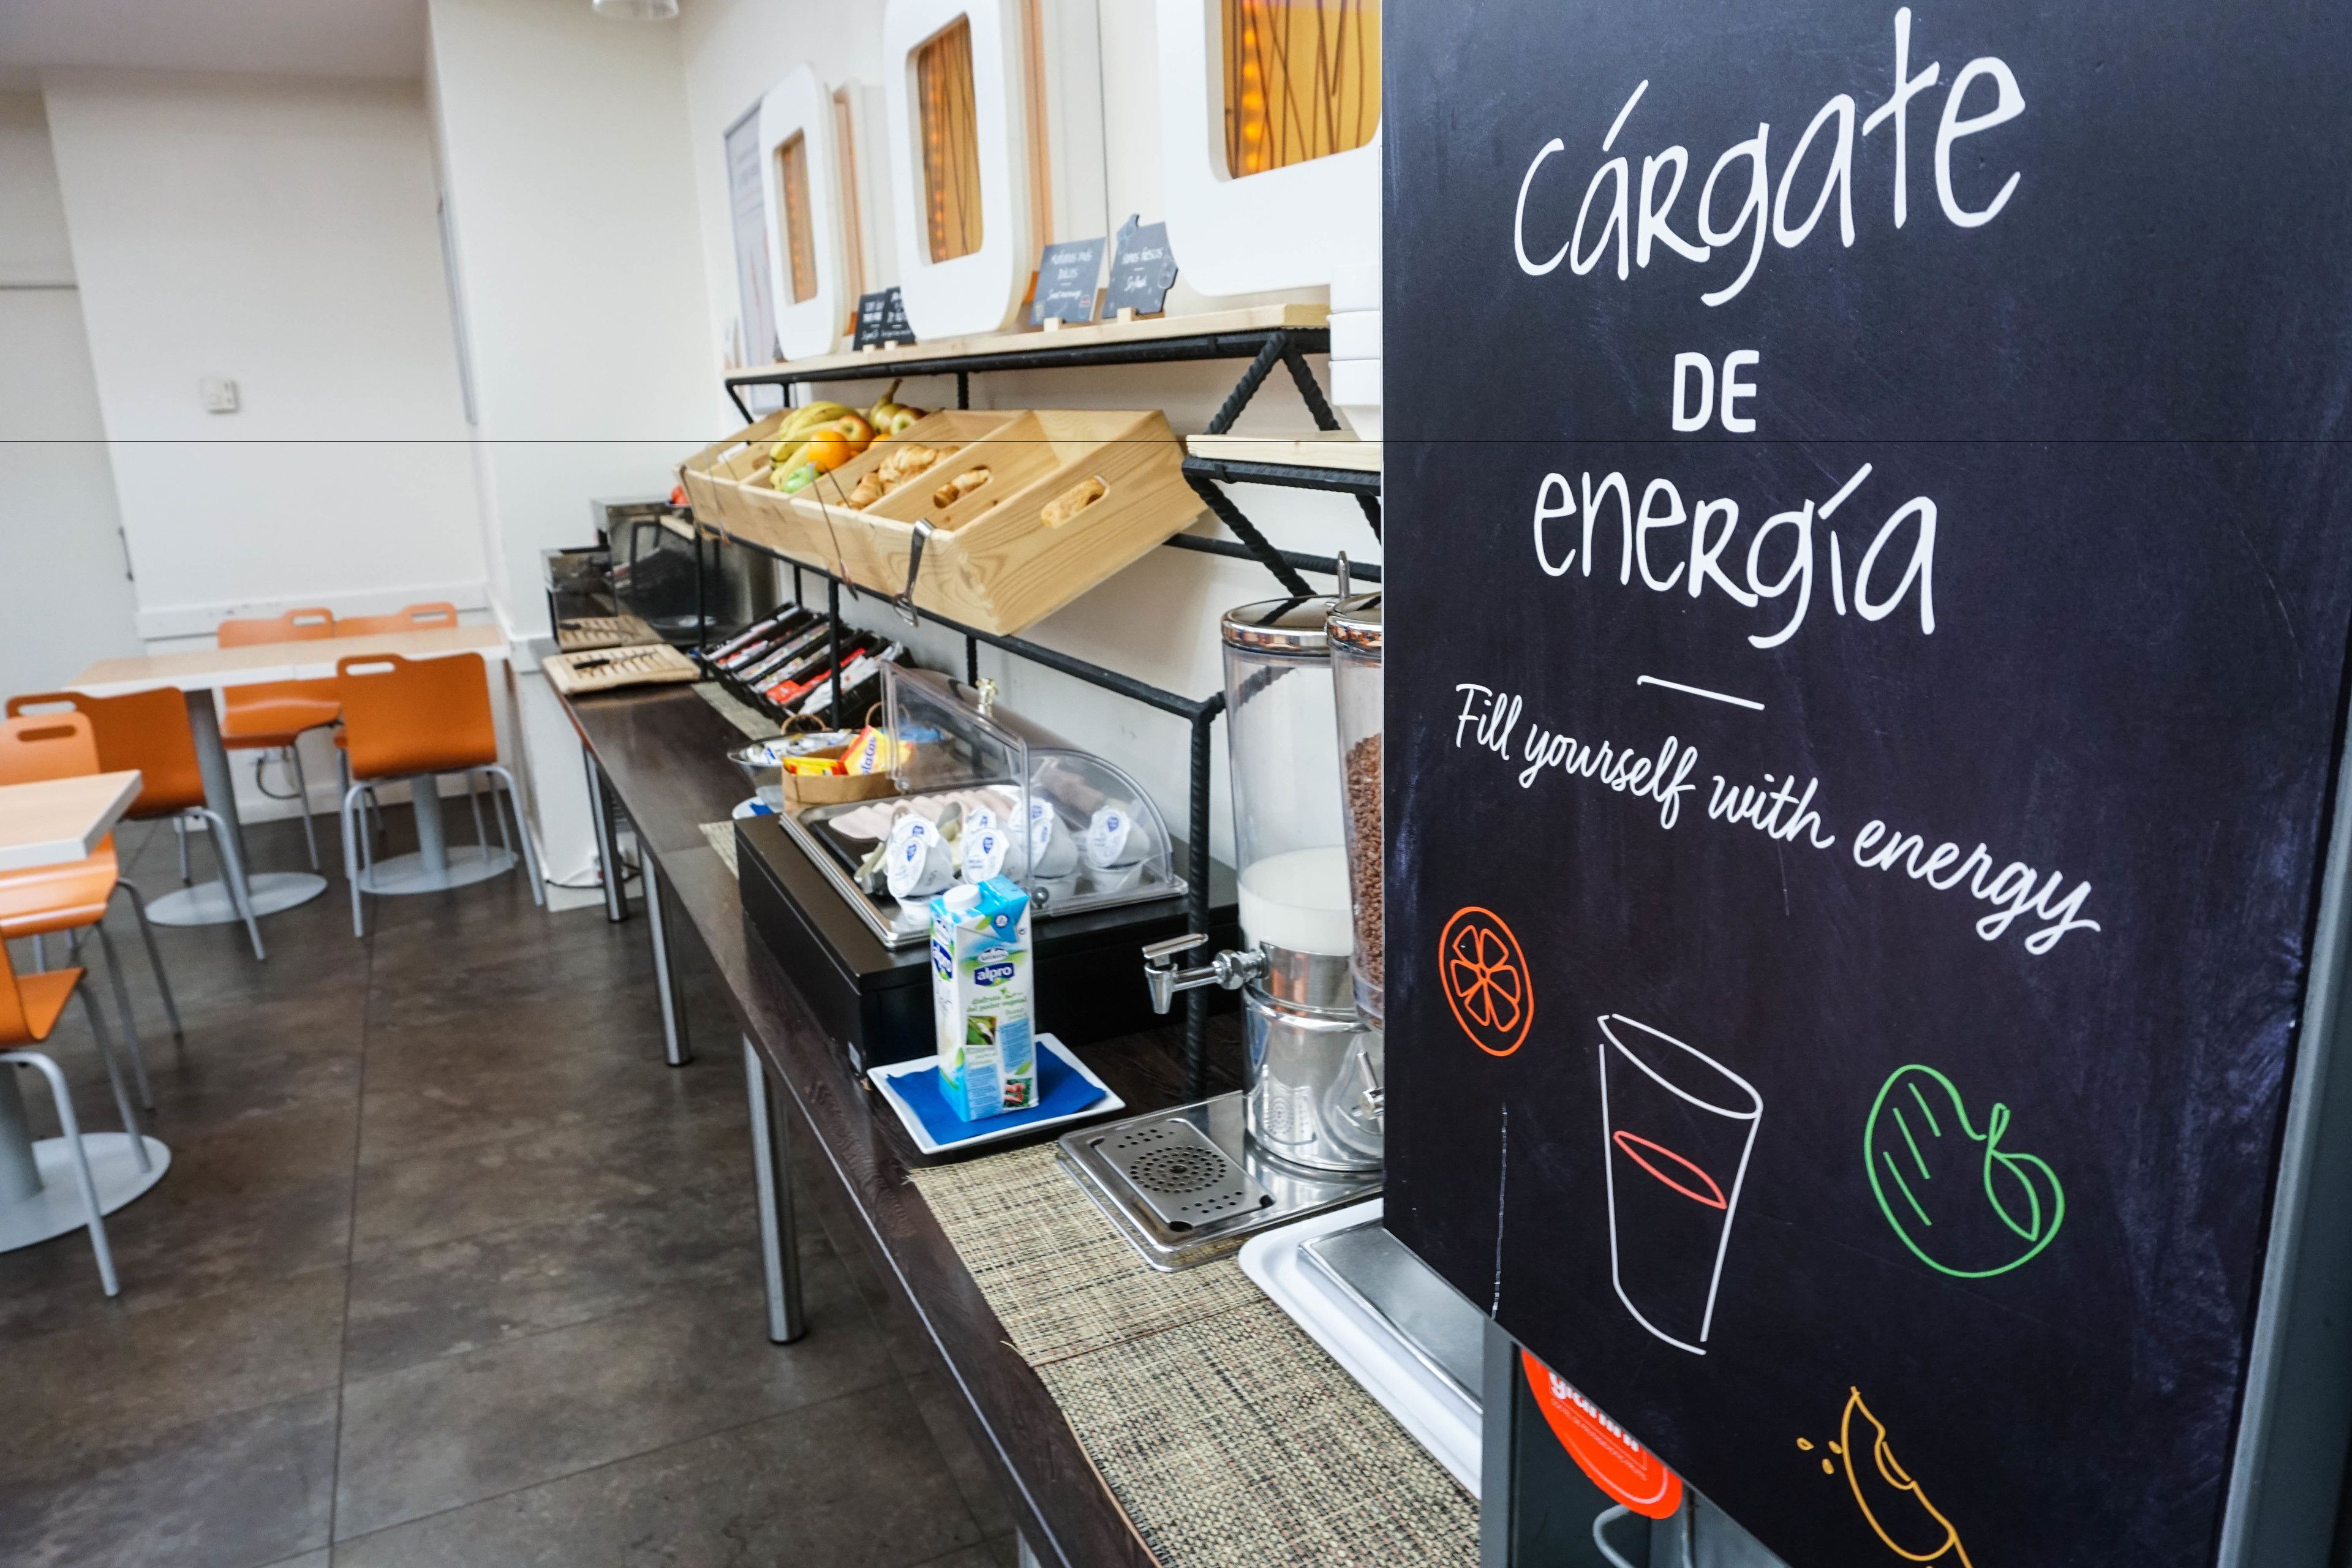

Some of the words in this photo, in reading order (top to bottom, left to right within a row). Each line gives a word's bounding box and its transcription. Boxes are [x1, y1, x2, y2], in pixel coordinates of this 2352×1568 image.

[1672, 350, 1760, 433] DE
[1534, 462, 1937, 649] energía
[1455, 684, 1523, 761] Fill
[1518, 723, 1698, 829] yourself
[1708, 774, 1835, 849] with
[1853, 820, 2101, 955] energy
[977, 967, 1012, 982] alpro
